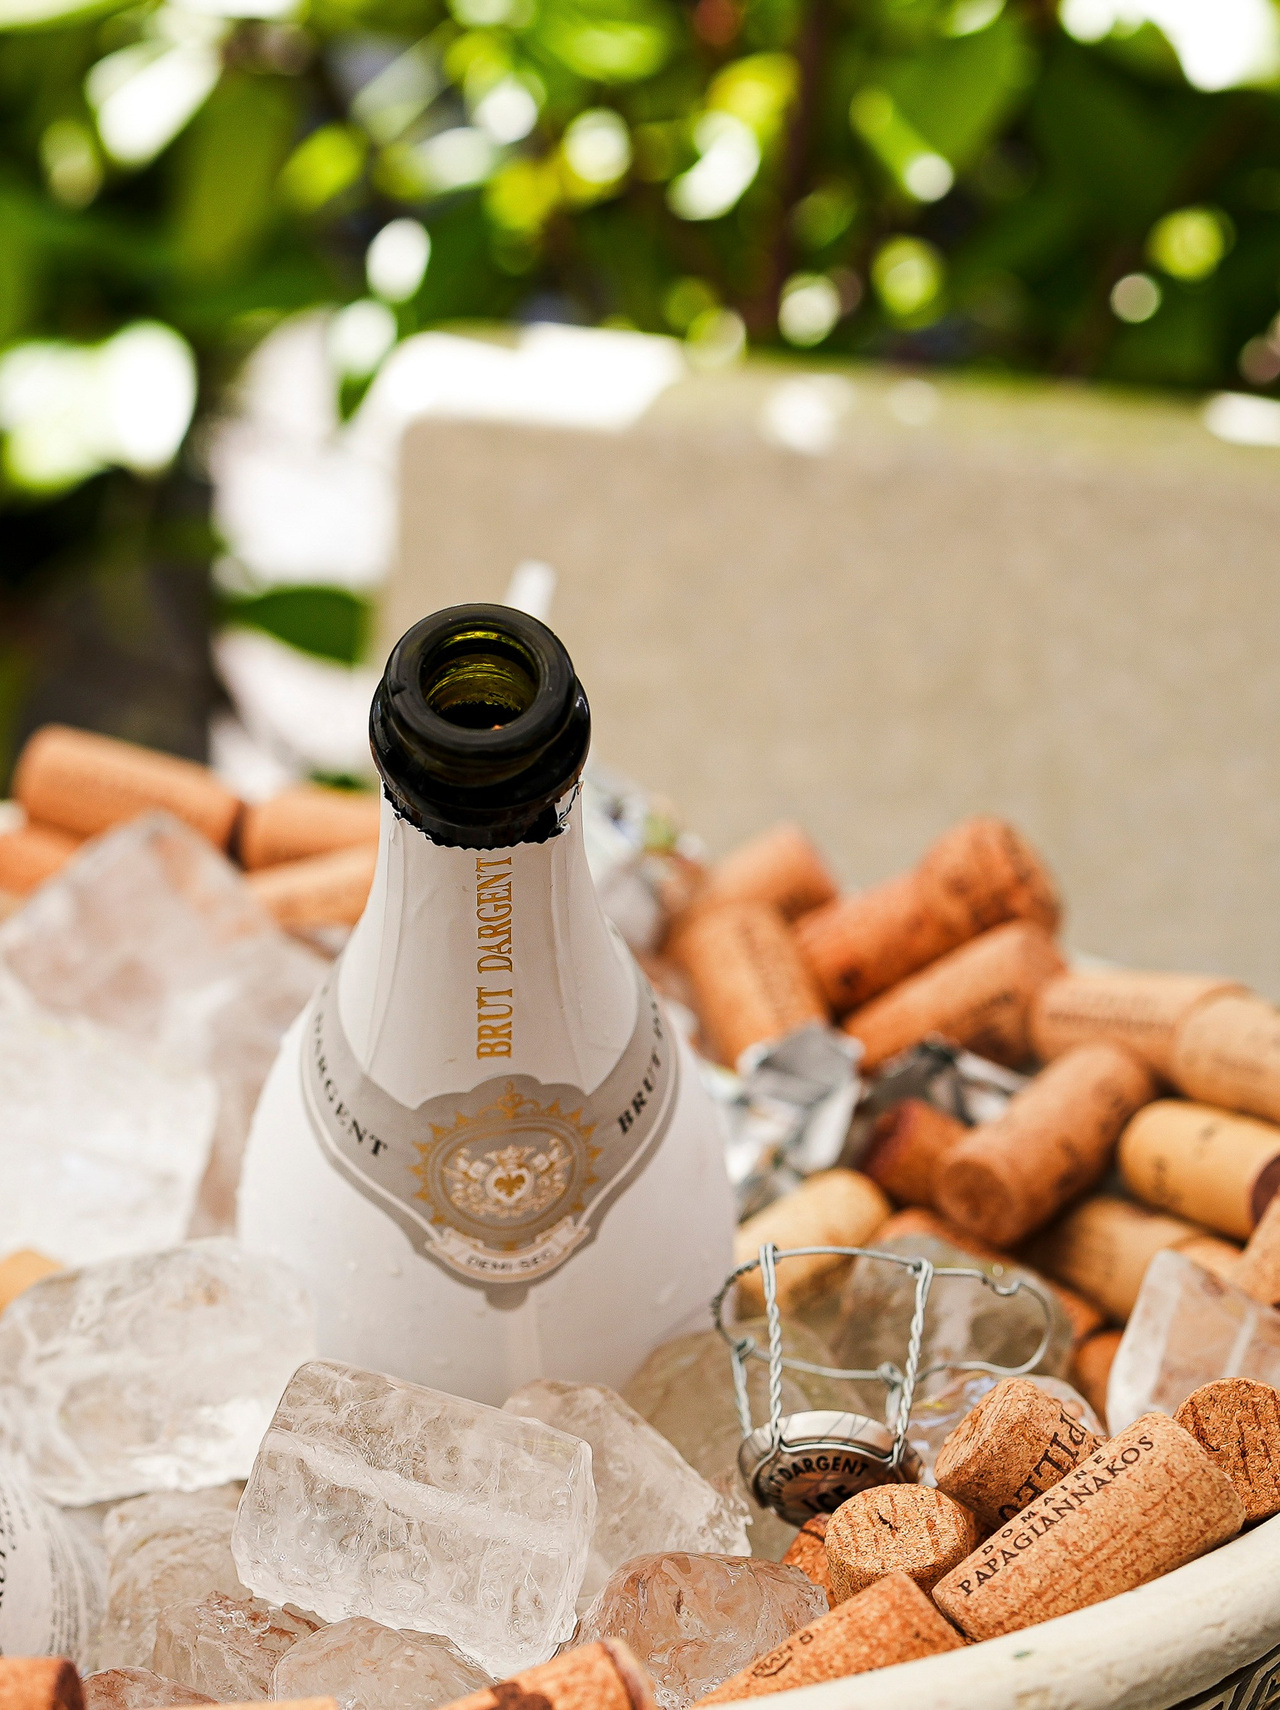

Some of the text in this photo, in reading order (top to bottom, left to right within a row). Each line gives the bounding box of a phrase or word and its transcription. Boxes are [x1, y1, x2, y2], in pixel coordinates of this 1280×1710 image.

[474, 855, 515, 1060] BRUT DARGENT
[616, 1044, 662, 1135] BRUT
[778, 1455, 870, 1481] DARGENT
[957, 1435, 1155, 1597] PAPAGIANNAKOS
[981, 1454, 1108, 1556] DOMAINE
